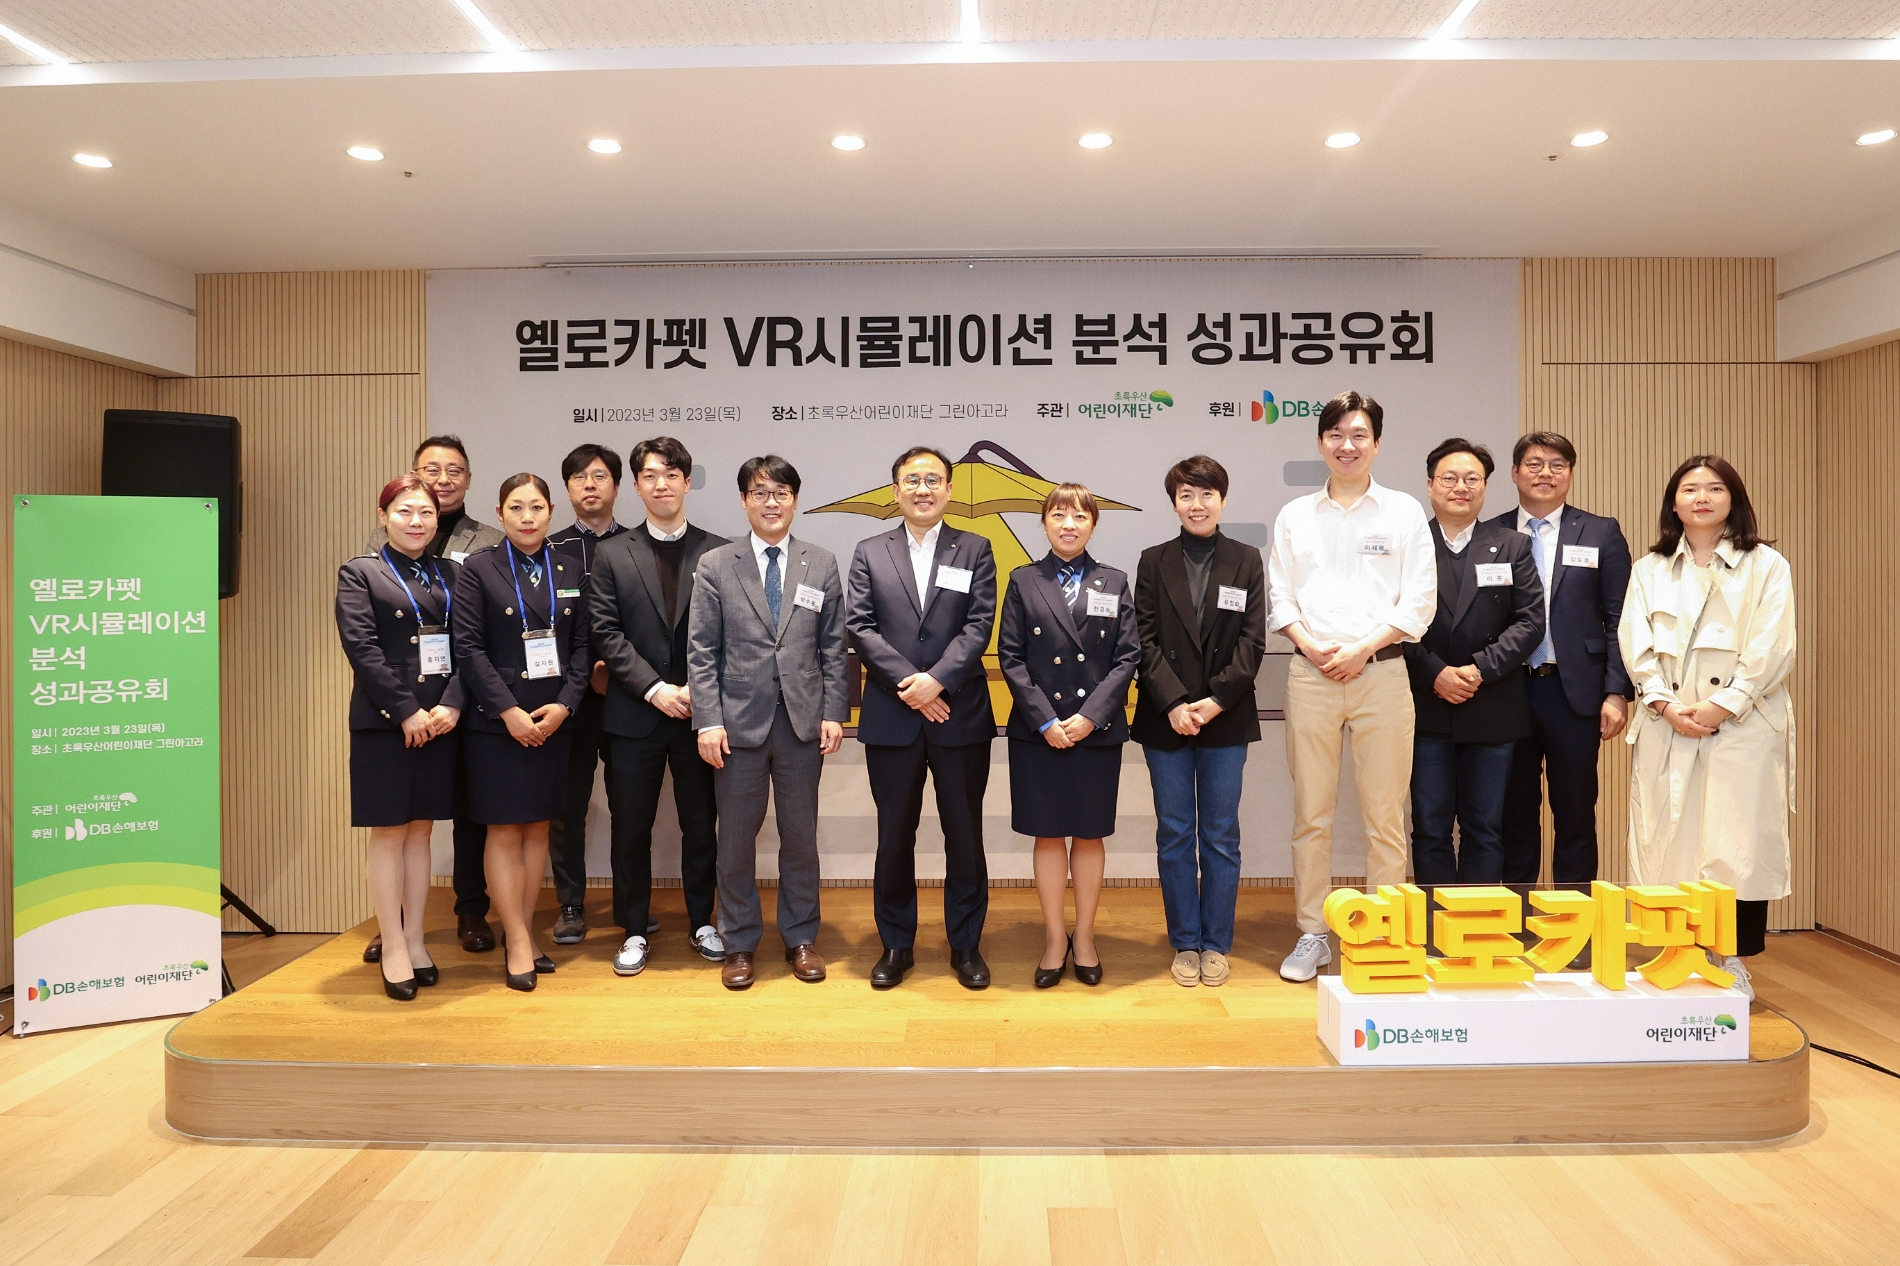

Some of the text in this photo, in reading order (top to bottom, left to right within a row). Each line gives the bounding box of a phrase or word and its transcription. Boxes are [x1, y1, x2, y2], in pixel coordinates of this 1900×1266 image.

[516, 310, 1433, 371] 옐로카펫 VR시뮬레이션 분석 성과공유회
[573, 406, 740, 422] 일시 2023년 3월 23일(목)
[772, 404, 1008, 420] 장소 초록우산어린이재단 그린아고라
[1037, 403, 1153, 418] 주관 어린이재단
[1209, 400, 1325, 417] 후원 DB손
[30, 578, 141, 601] 옐로카펫
[29, 611, 205, 635] VR시뮬레이션
[29, 646, 85, 670] 분석
[30, 678, 167, 706] 성과공유회
[32, 723, 165, 738] 일시 2023년 3월 23일(목)
[31, 737, 204, 755] 장소 초록우산어린이재단 그린아고라
[32, 801, 122, 815] 주관 어린이재단
[32, 828, 52, 839] 후원
[1323, 880, 1737, 994] 옐로카펫
[135, 970, 193, 985] 어린이재단
[1647, 1027, 1716, 1042] 어린이재단
